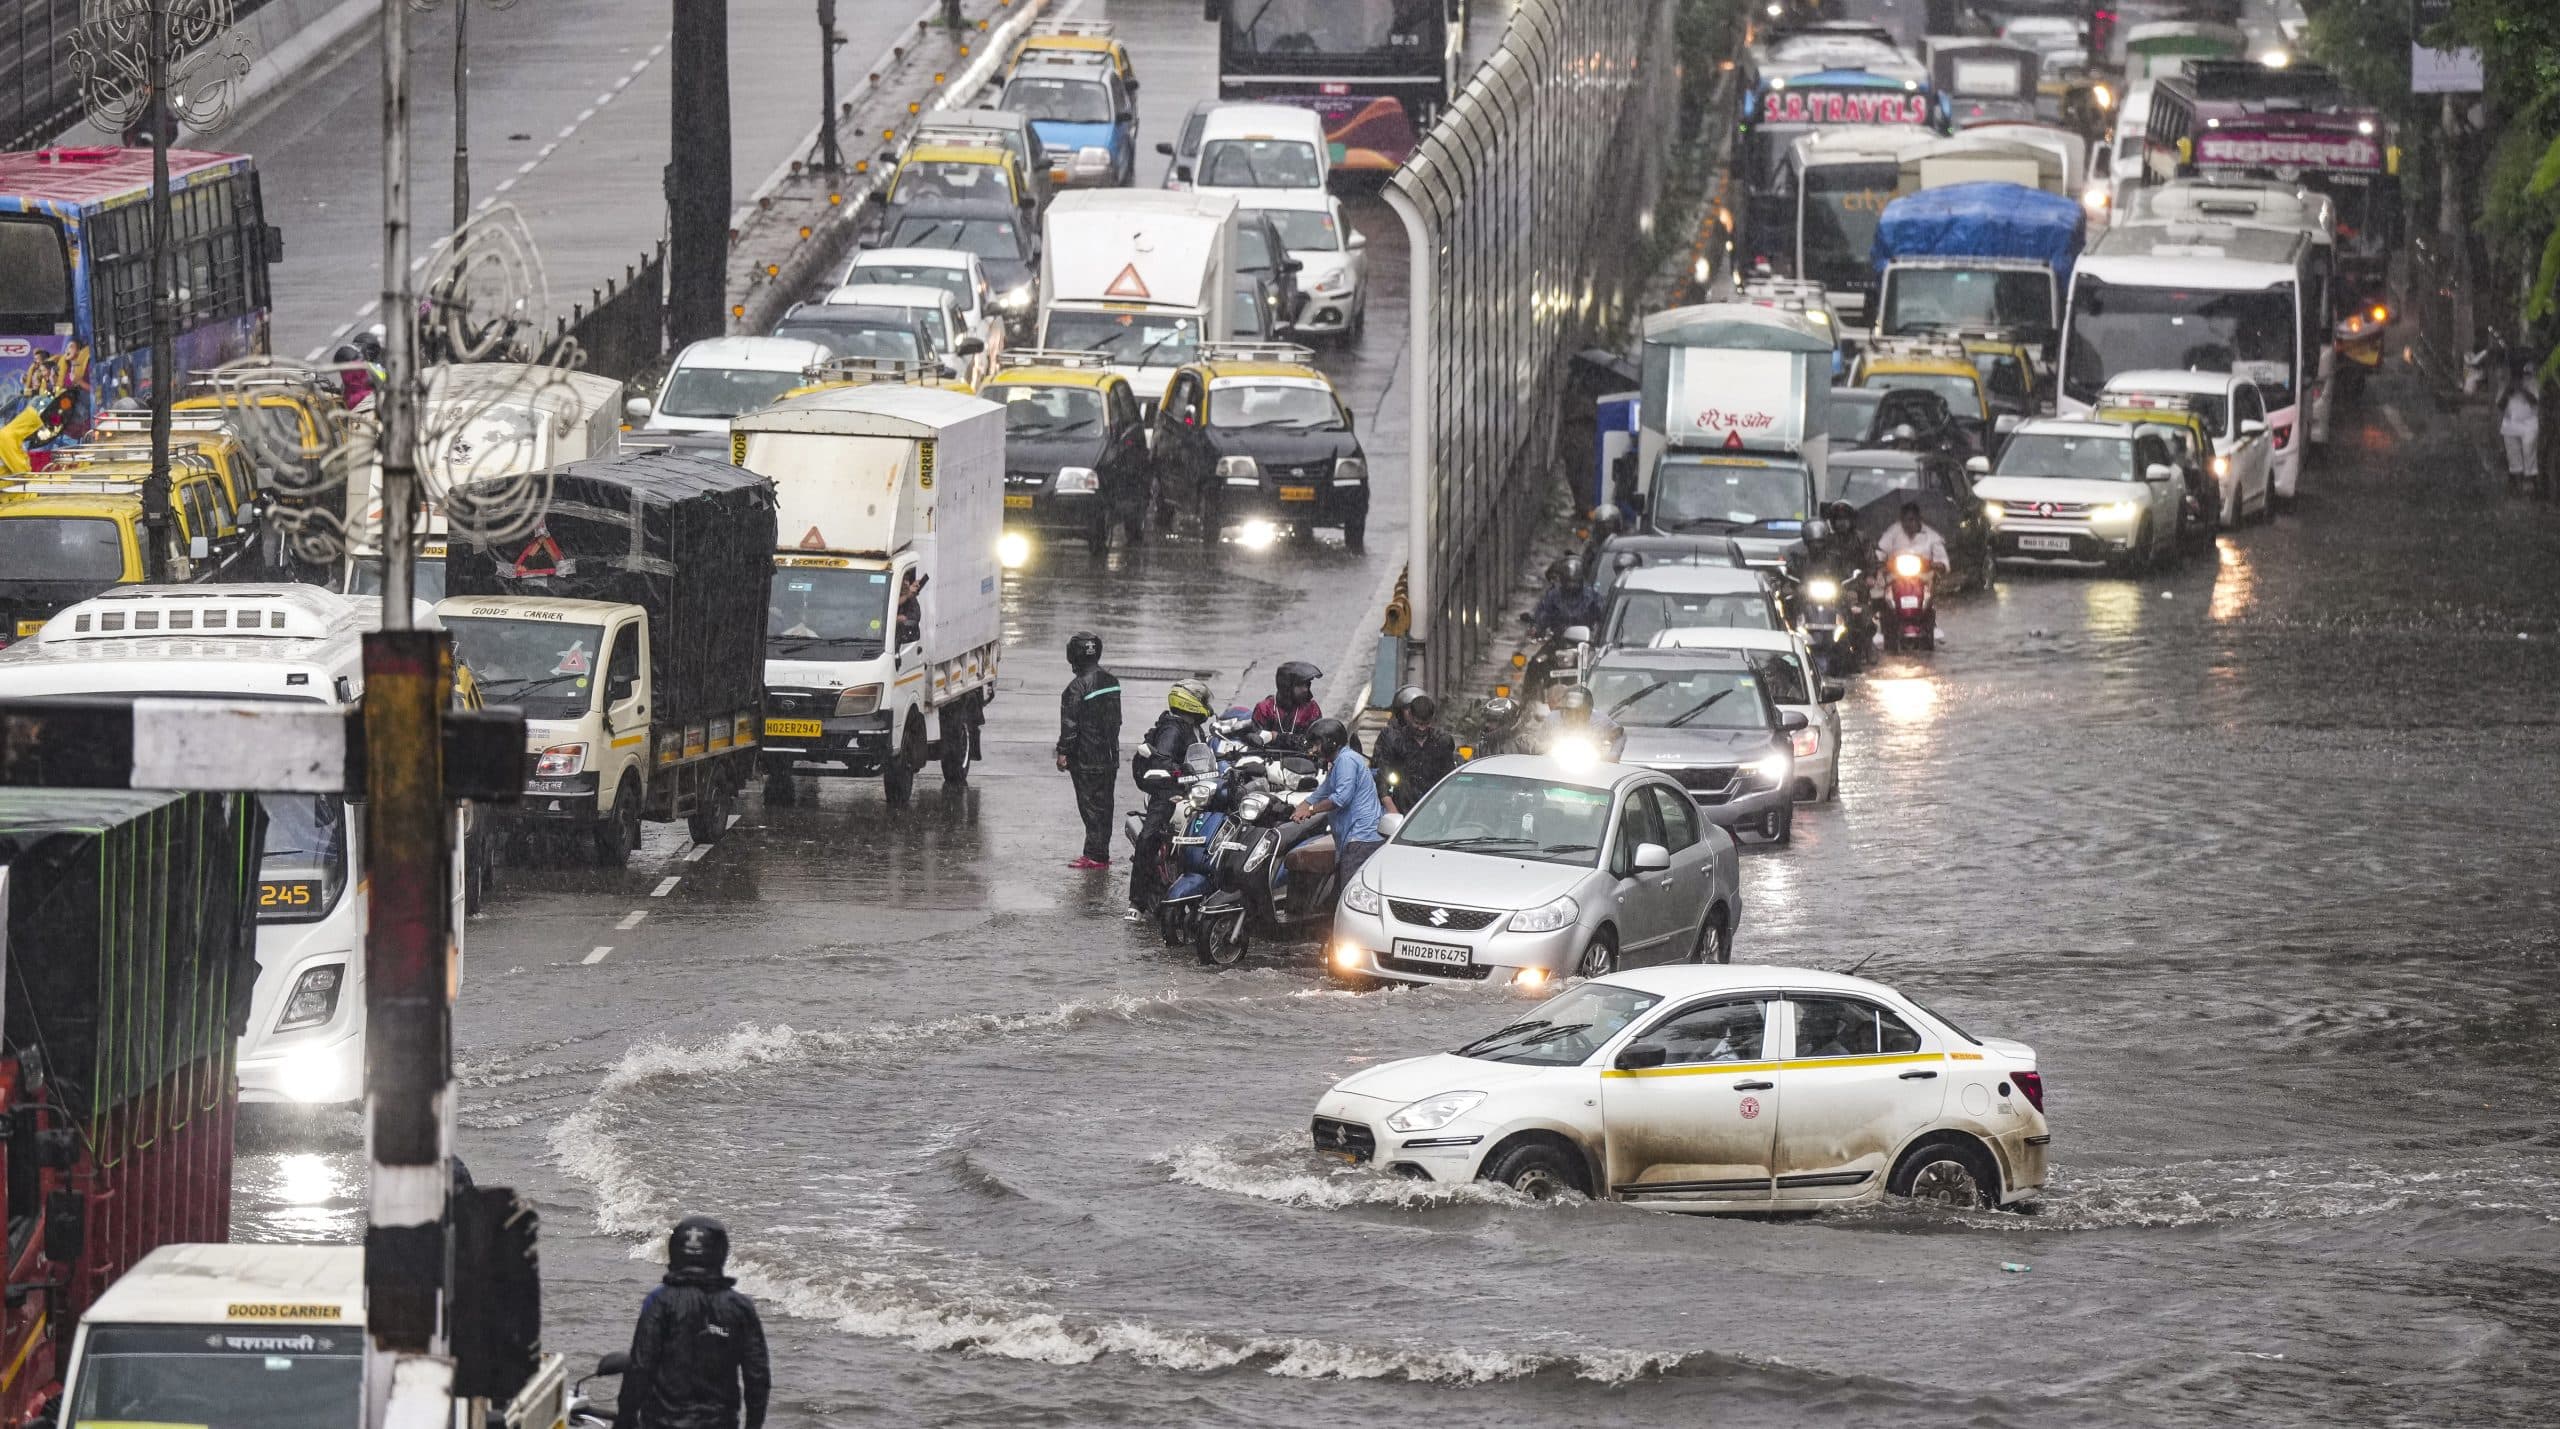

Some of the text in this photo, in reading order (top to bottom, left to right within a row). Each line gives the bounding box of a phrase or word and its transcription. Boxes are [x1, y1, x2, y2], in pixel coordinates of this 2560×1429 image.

[734, 433, 747, 466] GOOD
[921, 441, 934, 486] CARRIER
[471, 607, 564, 621] GOODS CARRIER
[765, 722, 821, 734] H02ER2947
[260, 885, 311, 906] 245
[1401, 943, 1467, 963] MH02BY6475
[228, 1304, 342, 1318] GOODS CARRIER
